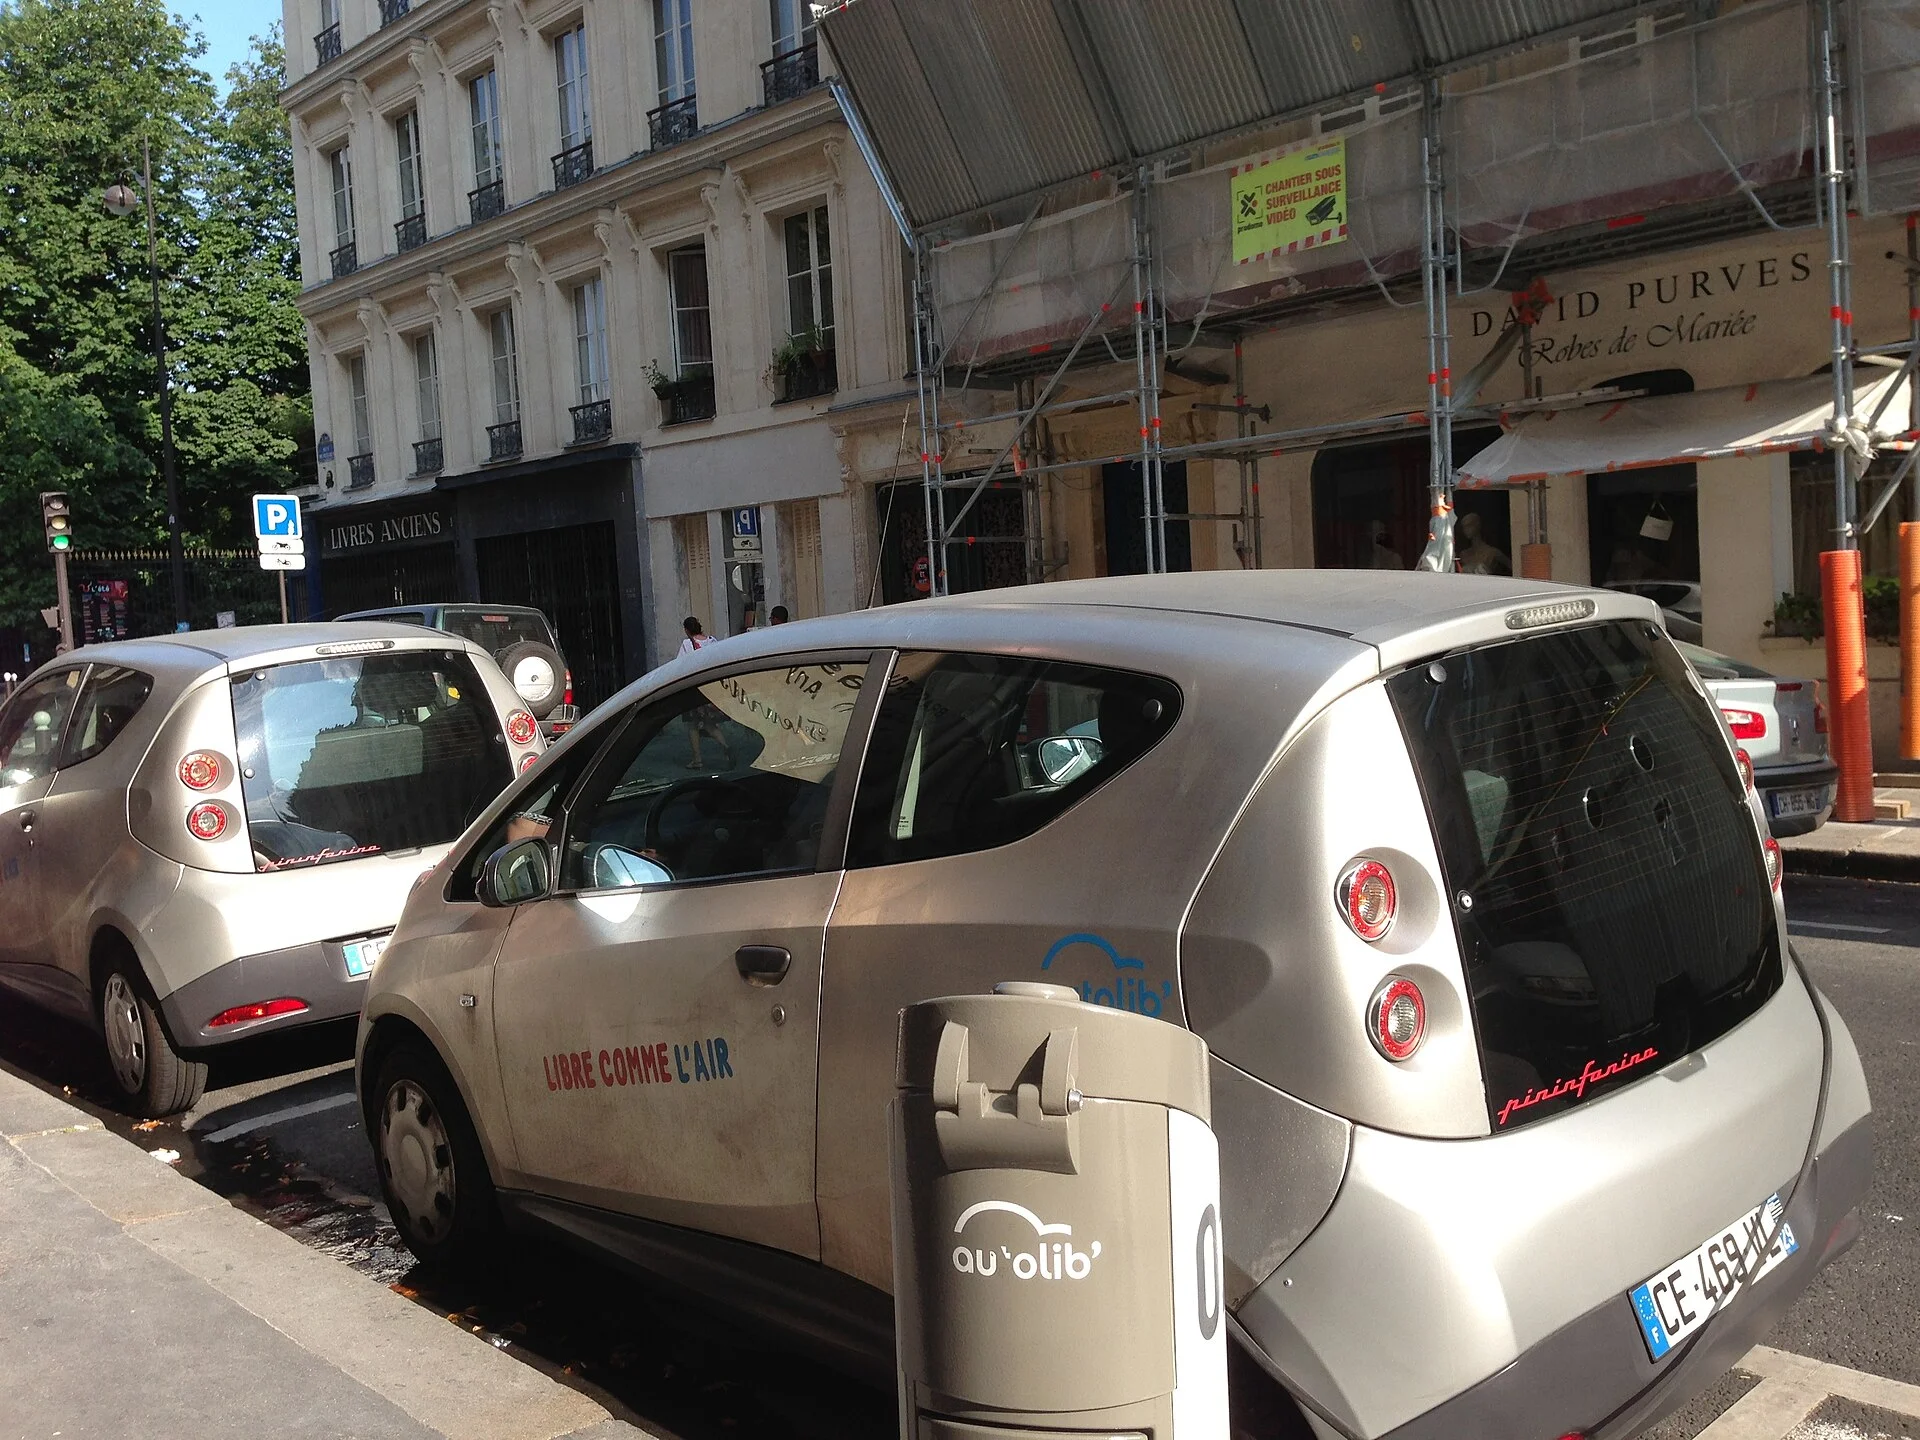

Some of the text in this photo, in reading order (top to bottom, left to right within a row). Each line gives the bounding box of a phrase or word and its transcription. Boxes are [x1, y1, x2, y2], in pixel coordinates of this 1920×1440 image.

[1265, 164, 1341, 195] CHANTIER SOUS
[1266, 180, 1342, 210] SURVEILLANCE
[1266, 207, 1296, 225] VIDÉO
[1627, 252, 1812, 310] PURVES
[1517, 309, 1757, 368] Robes de Mariée
[266, 503, 288, 531] P
[330, 511, 441, 550] LIVRES ANCIENS
[257, 844, 381, 872] pininfarina
[1074, 976, 1172, 1018] tolib'
[543, 1037, 734, 1092] LIBRE COMME L'AIR
[1497, 1046, 1659, 1126] pininfarina
[1651, 1326, 1660, 1344] F
